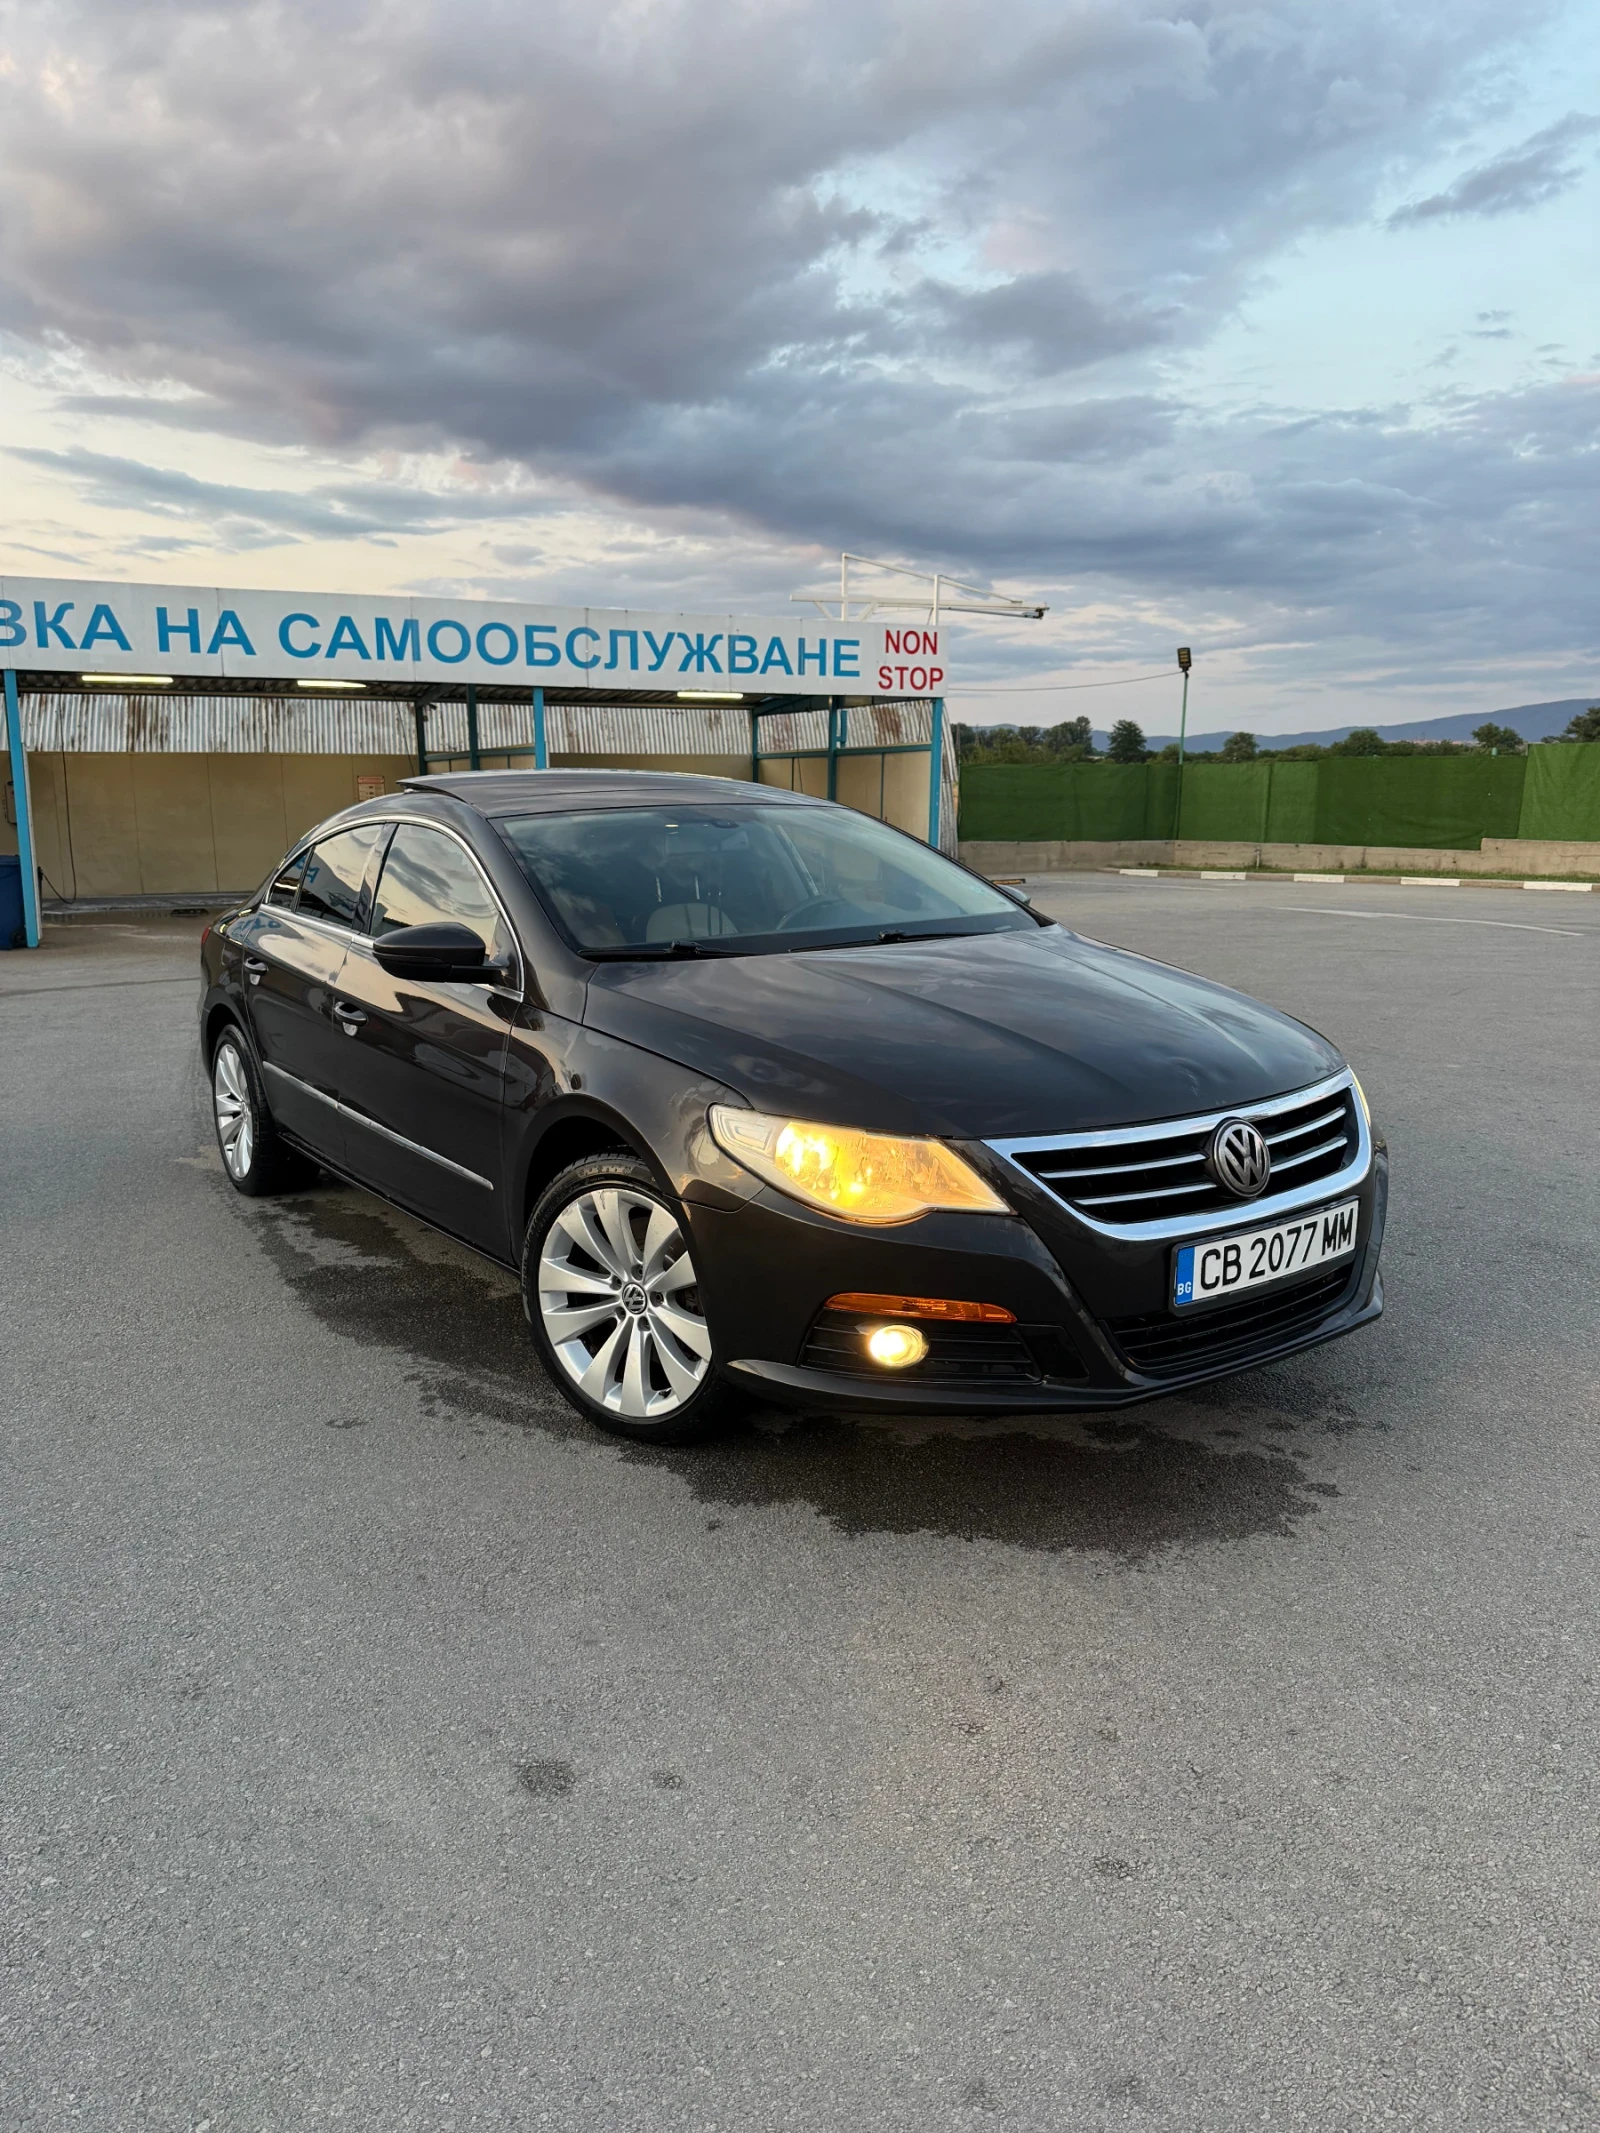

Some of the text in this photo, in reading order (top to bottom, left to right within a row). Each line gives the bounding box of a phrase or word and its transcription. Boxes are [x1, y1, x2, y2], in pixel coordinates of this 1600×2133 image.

[0, 599, 860, 678] ВКА НА САМООБСЛУЖВАНЕ
[885, 629, 938, 655] NON
[878, 665, 944, 691] STOP
[1200, 1207, 1355, 1291] CB 2077 MM
[1177, 1281, 1192, 1296] BG
